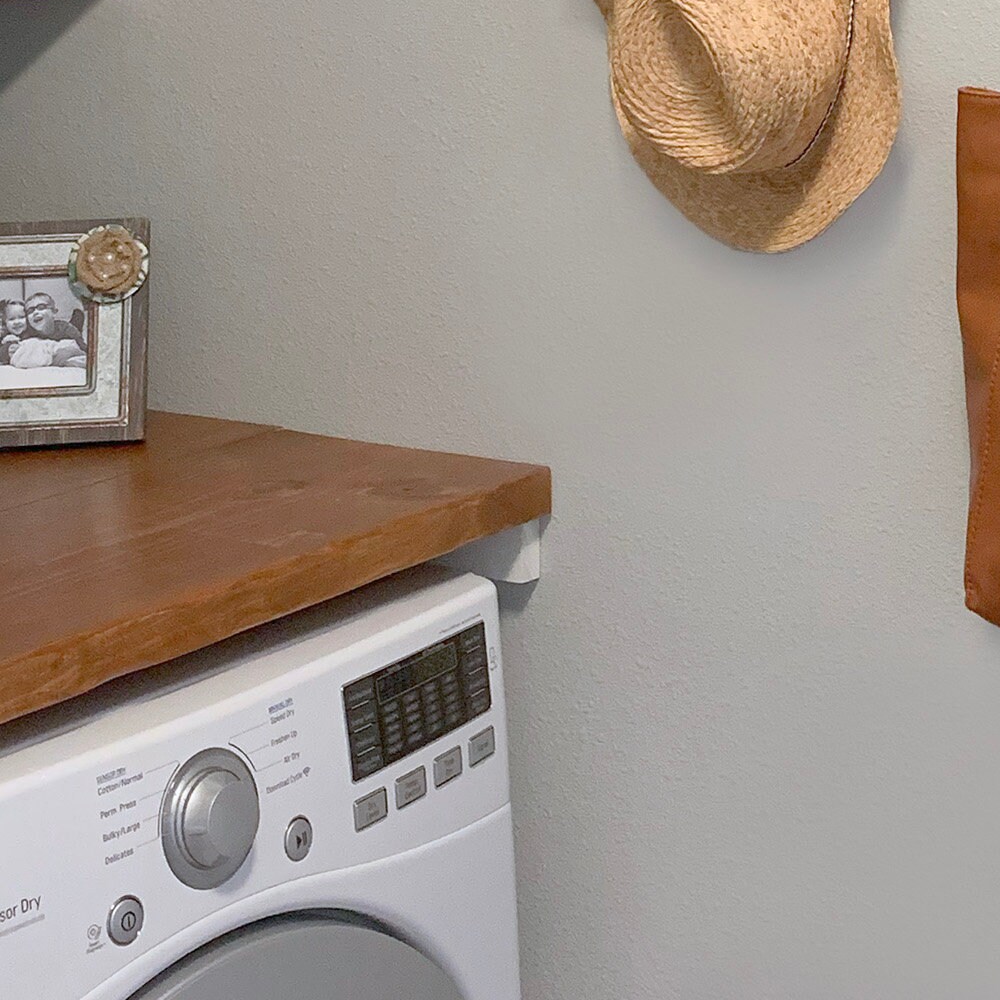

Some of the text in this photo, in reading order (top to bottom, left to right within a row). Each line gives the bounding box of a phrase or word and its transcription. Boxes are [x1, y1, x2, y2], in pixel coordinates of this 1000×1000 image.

[97, 772, 144, 796] Cotton/Normal
[100, 807, 117, 820] Perm
[102, 821, 141, 843] Bulky/Large
[104, 847, 135, 865] Delicates
[20, 895, 42, 914] Dry
